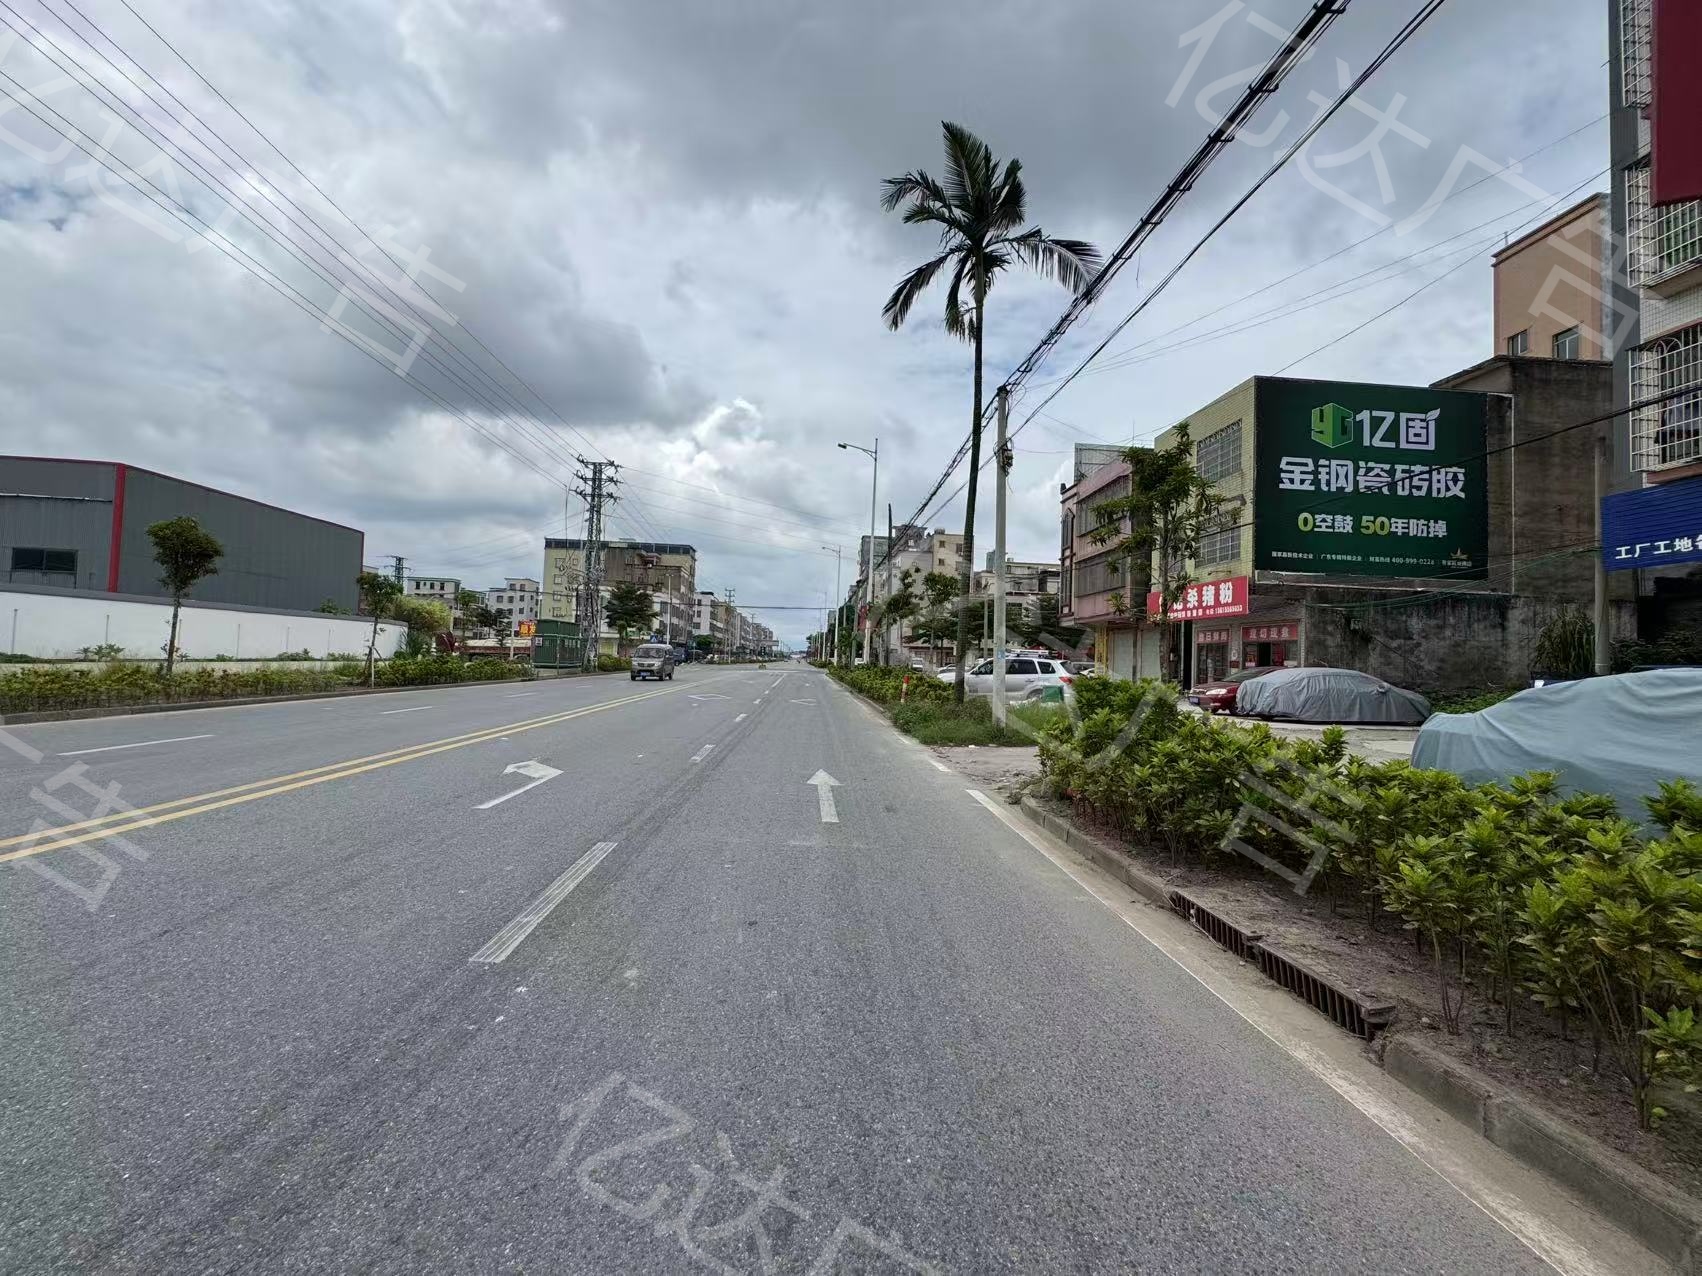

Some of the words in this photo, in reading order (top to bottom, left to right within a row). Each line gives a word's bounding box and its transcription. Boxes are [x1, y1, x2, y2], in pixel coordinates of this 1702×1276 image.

[1356, 408, 1440, 450] 亿固
[1279, 457, 1465, 499] 金钢瓷砖胶
[1298, 512, 1353, 534] 0空鼓
[1361, 515, 1447, 538] 50年防掉
[1159, 581, 1233, 612] 杀猪粉
